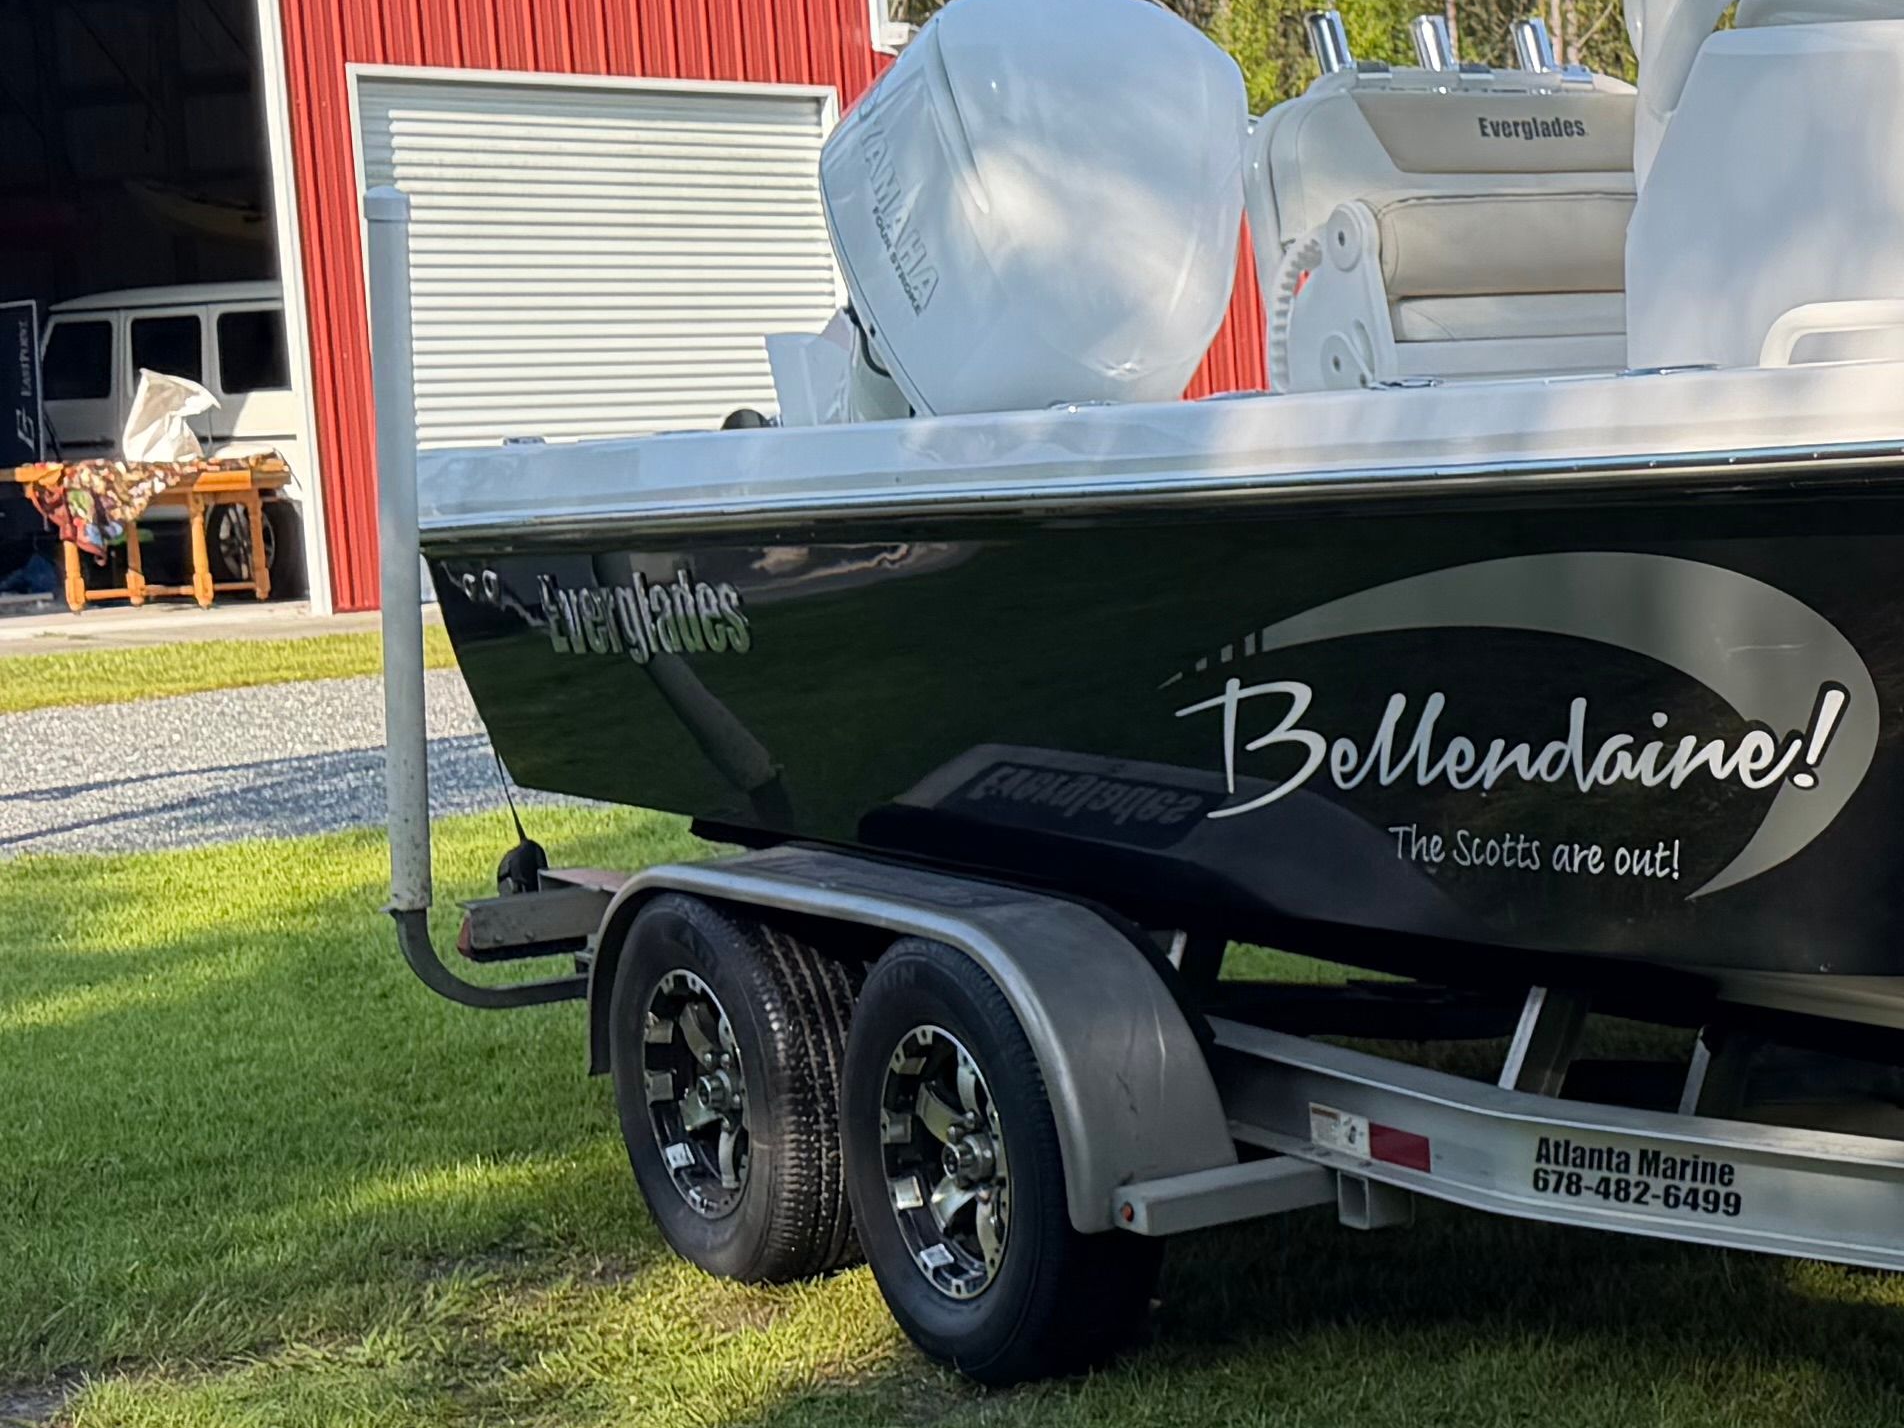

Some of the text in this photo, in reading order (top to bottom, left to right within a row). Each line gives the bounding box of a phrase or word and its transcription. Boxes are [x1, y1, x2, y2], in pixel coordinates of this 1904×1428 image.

[1478, 117, 1586, 140] Everglades
[536, 569, 751, 665] Everglades
[1174, 676, 1847, 819] Bellendaine!
[1389, 825, 1680, 881] The Scotts are out!
[1534, 1136, 1736, 1186] Atlanta Marine
[1532, 1168, 1743, 1217] 678-482-6499
